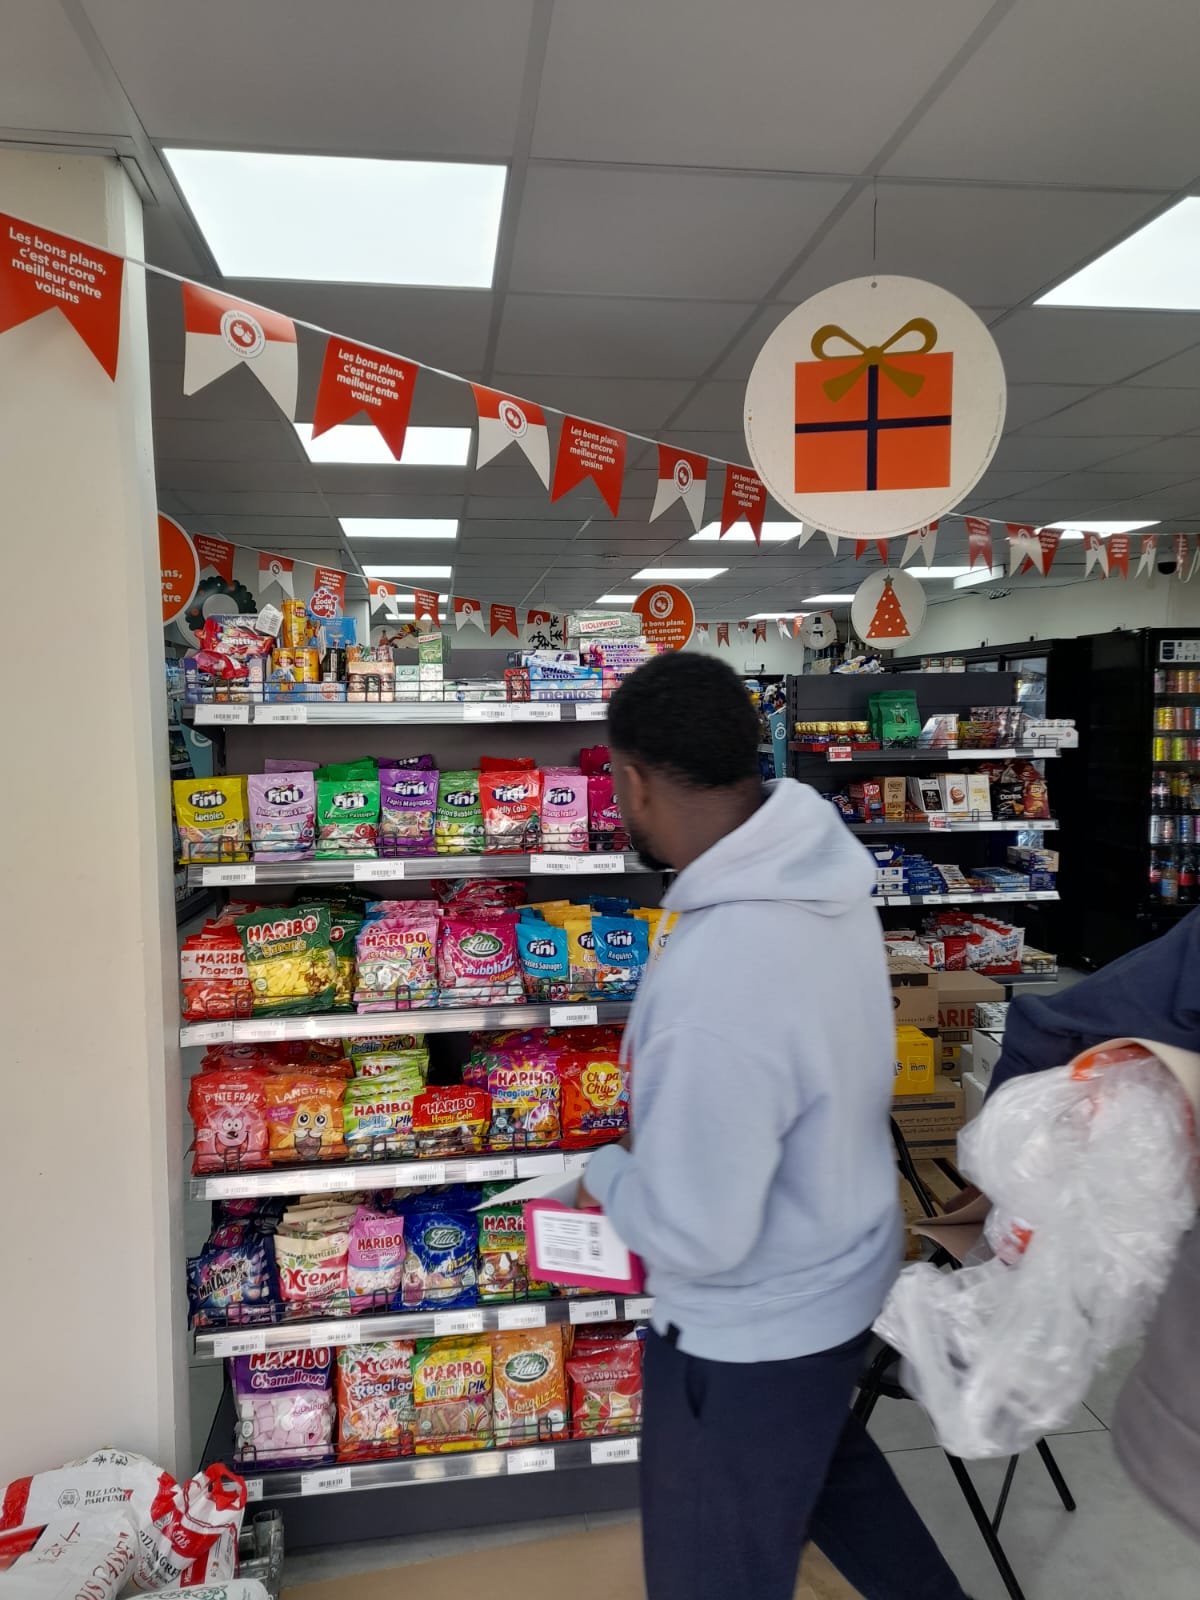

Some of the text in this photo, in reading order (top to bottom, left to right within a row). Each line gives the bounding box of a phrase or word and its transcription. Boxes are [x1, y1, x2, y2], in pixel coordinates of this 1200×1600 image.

[9, 226, 107, 276] Les bons plans,
[19, 247, 96, 283] c'est encore
[12, 258, 102, 299] meilleur entre
[35, 281, 80, 304] voisins
[338, 348, 404, 380] Les bons plans,
[343, 364, 396, 388] c'est encore
[337, 374, 399, 400] meilleur entre
[351, 390, 382, 406] voisins
[160, 569, 183, 579] ns,
[162, 592, 182, 603] tre
[581, 619, 620, 631] HOLLYWOOD
[267, 786, 300, 803] Fini
[394, 783, 425, 795] Fini
[545, 789, 572, 804] Fini
[191, 791, 223, 807] Fini
[446, 791, 475, 805] Fini
[512, 804, 527, 813] Cola
[247, 915, 318, 944] HARIBO
[364, 931, 427, 947] HARIBO
[580, 934, 595, 948] Fi
[606, 931, 633, 946] Fini
[529, 942, 555, 955] Fini
[607, 950, 634, 961] Requins
[195, 953, 247, 964] HARIBO
[199, 965, 244, 977] Tagada
[497, 1071, 555, 1086] HARIBO
[275, 1087, 333, 1105] LANGUES
[353, 1100, 412, 1117] HARIBO
[427, 1097, 476, 1116] HARIBO
[456, 1111, 473, 1120] Cola
[592, 1118, 623, 1128] BEST
[483, 1217, 526, 1232] HARI
[357, 1234, 403, 1251] HARIBO
[249, 1347, 330, 1370] HARIBO
[252, 1370, 326, 1388] Chamallows
[423, 1360, 485, 1382] HARIBO
